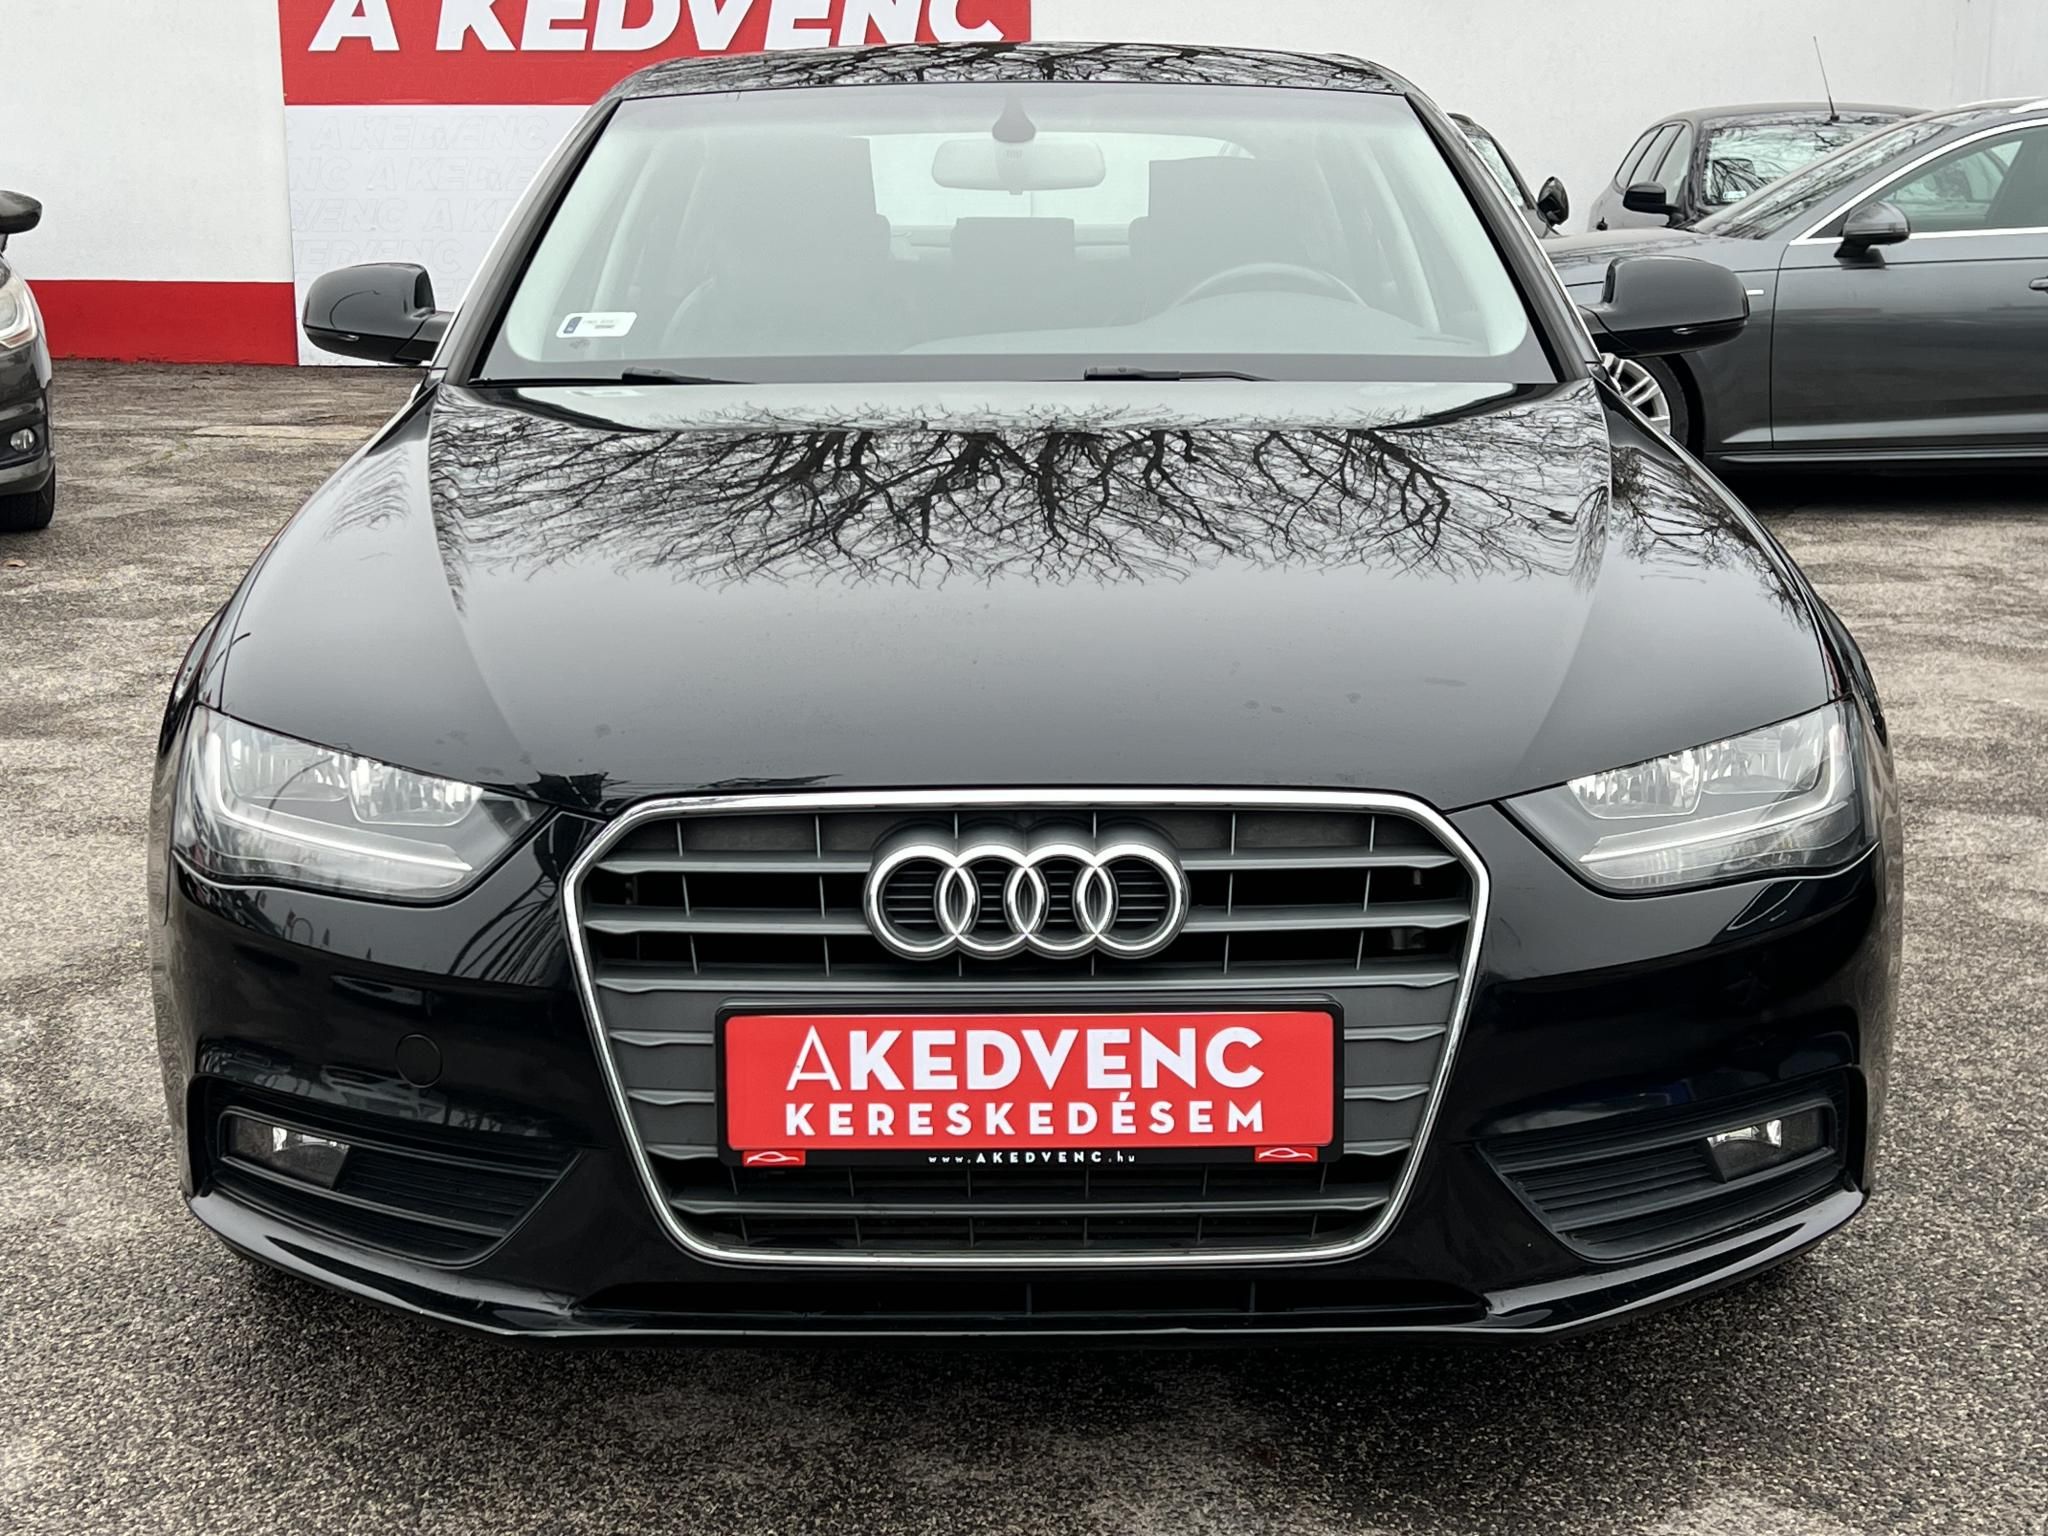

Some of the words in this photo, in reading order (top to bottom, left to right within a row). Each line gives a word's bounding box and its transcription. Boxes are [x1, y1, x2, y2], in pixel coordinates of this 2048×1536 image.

[308, 0, 401, 51] A
[436, 0, 1005, 51] KEDVENC
[785, 1092, 1264, 1136] KERESKEDÉSEM
[928, 1151, 1136, 1164] www.AKEDVENC.hu
